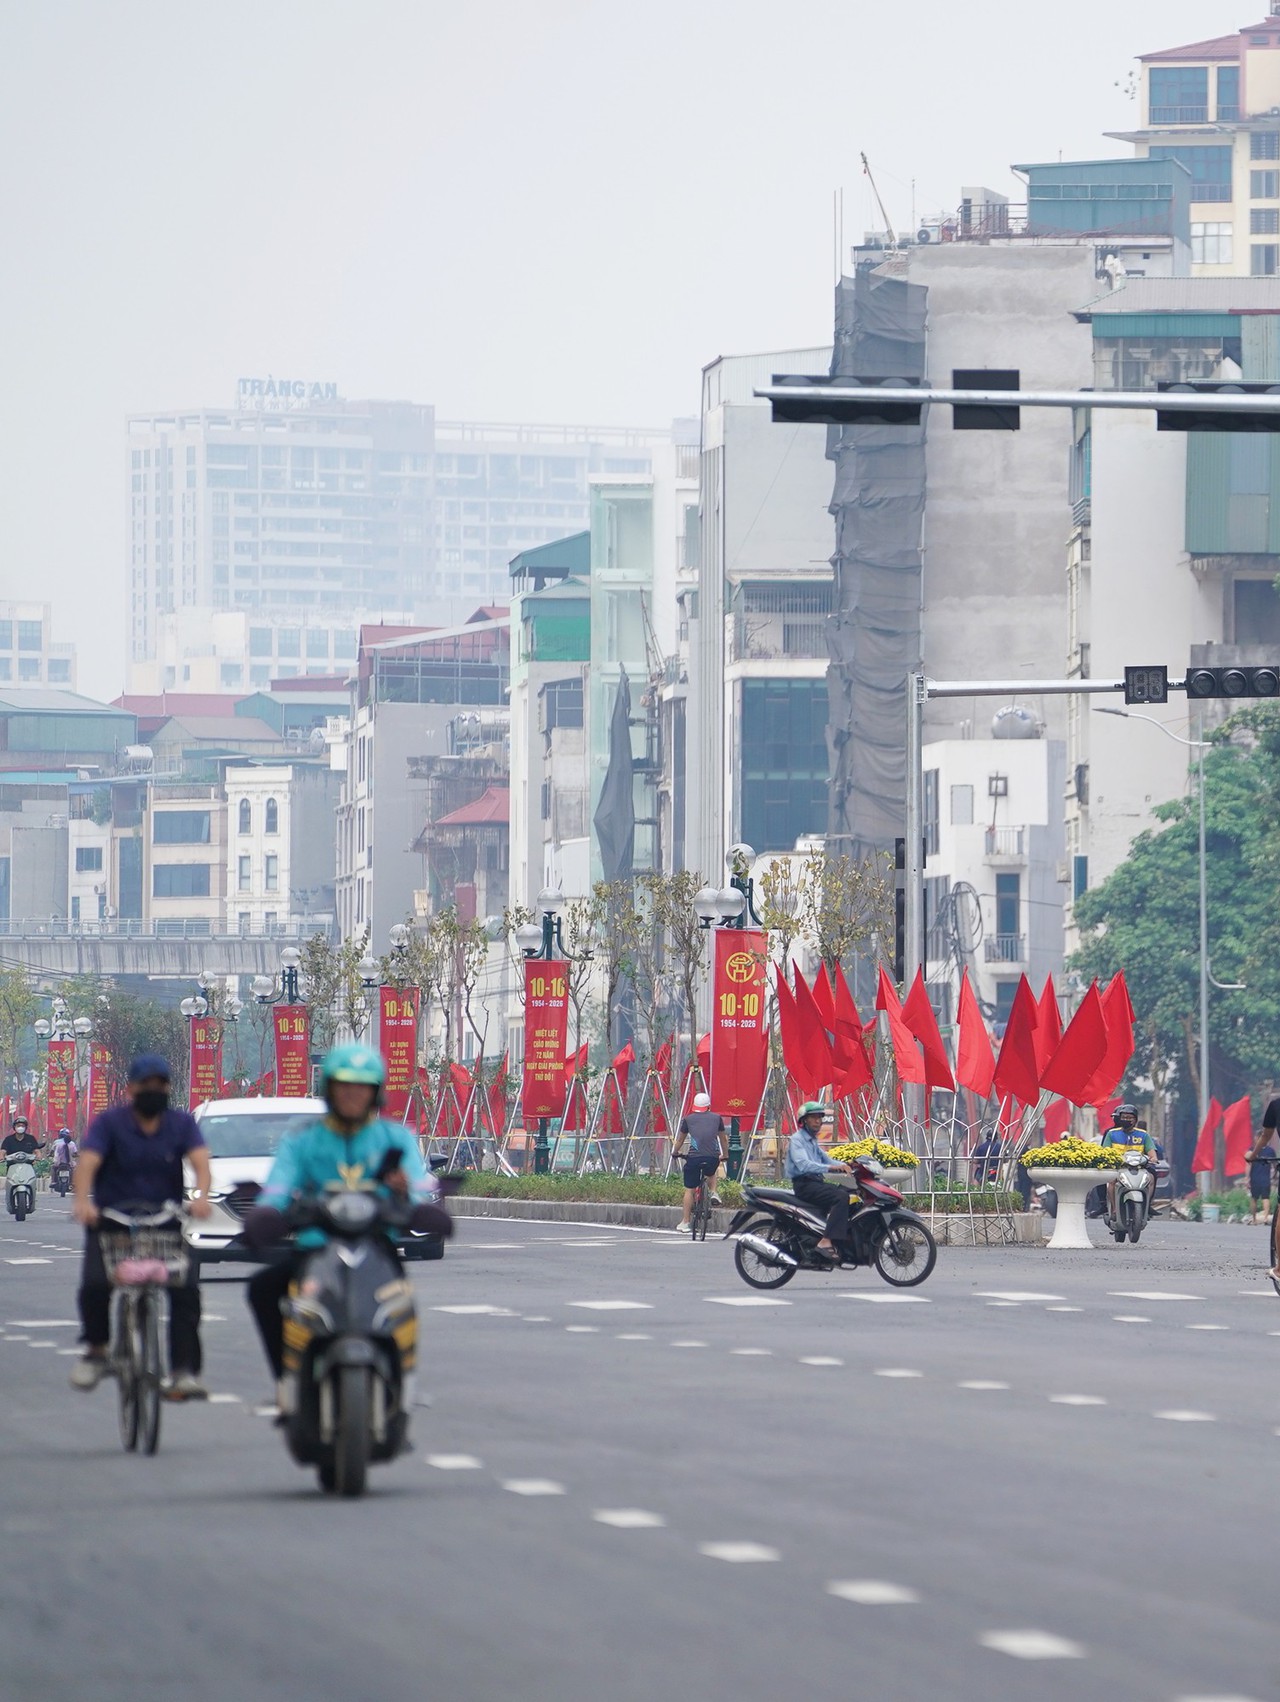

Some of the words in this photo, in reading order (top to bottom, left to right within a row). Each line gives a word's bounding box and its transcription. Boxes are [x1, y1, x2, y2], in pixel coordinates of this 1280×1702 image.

[238, 373, 306, 398] TRÀNG
[310, 381, 338, 400] AN
[721, 1019, 736, 1028] 1954
[740, 1019, 756, 1028] 2026
